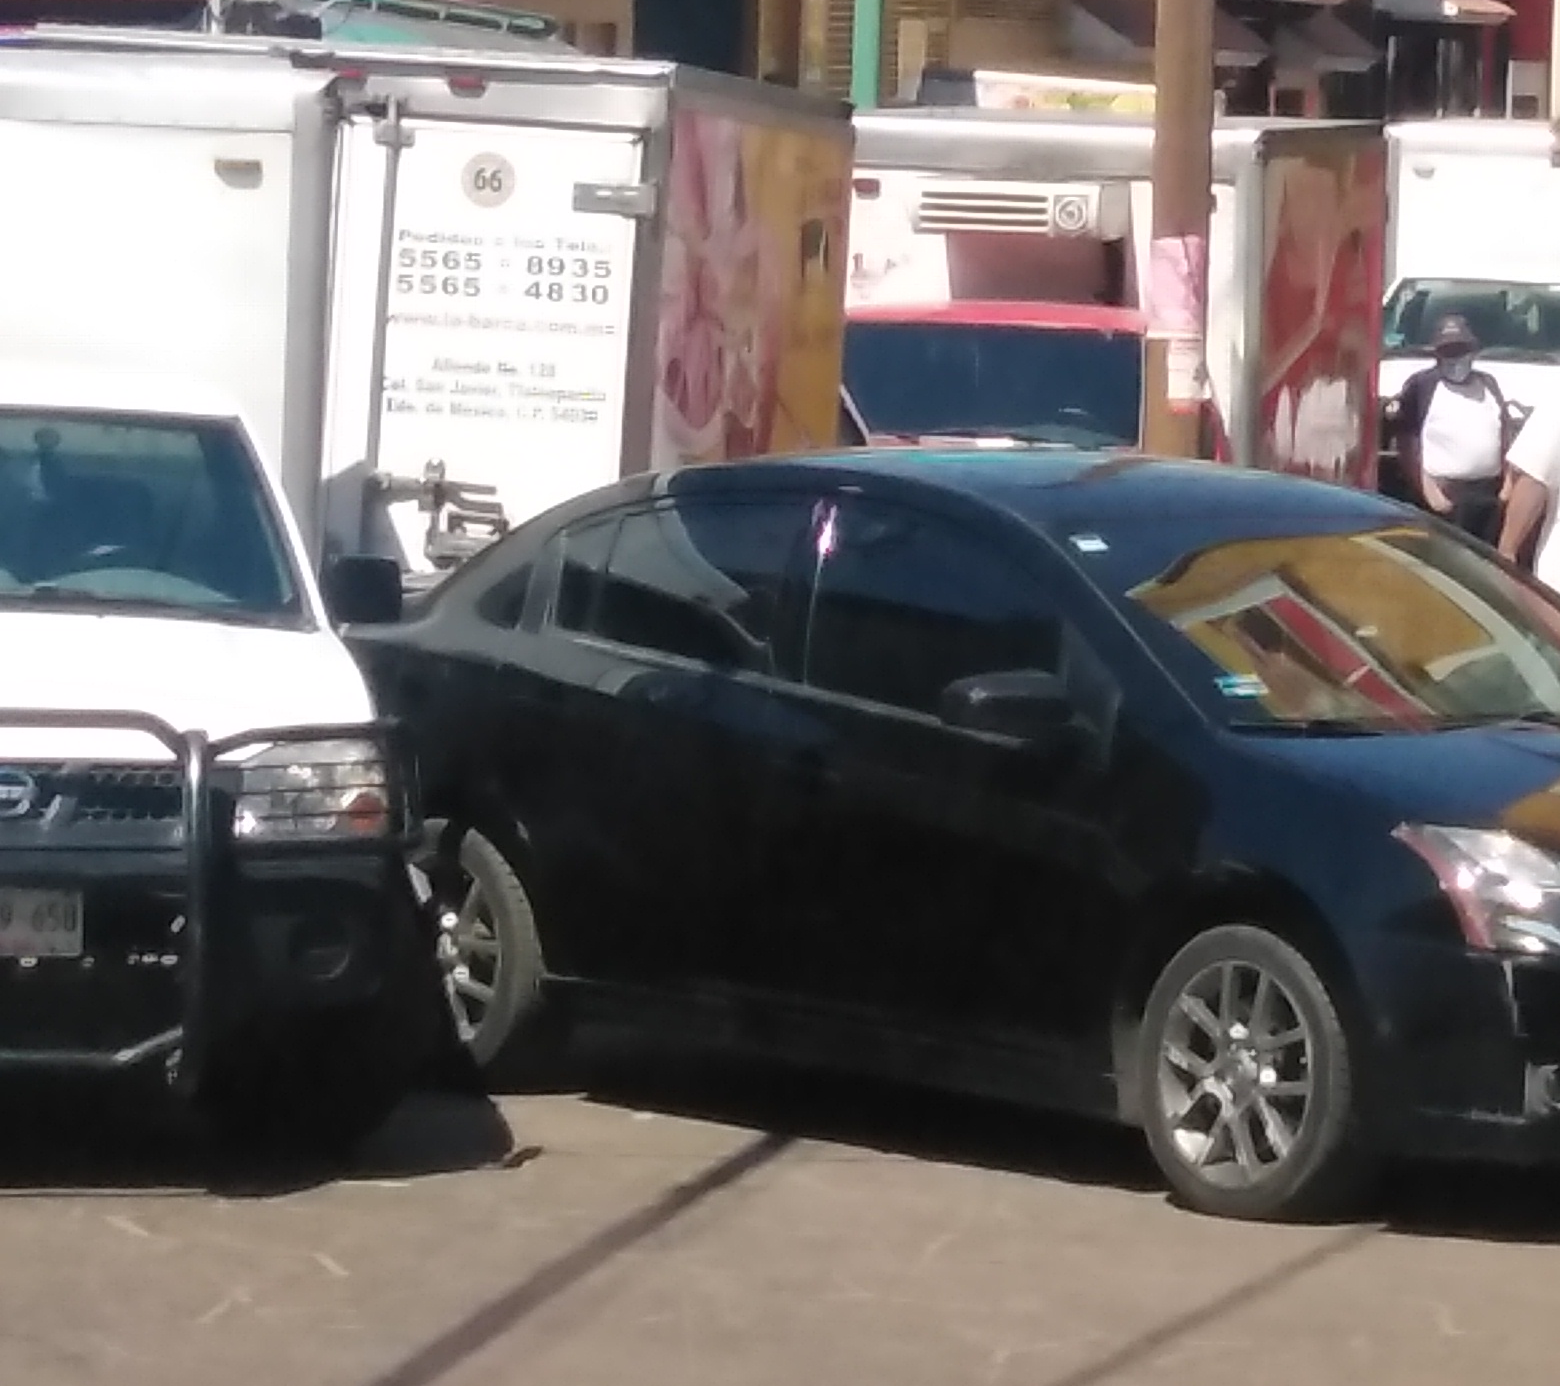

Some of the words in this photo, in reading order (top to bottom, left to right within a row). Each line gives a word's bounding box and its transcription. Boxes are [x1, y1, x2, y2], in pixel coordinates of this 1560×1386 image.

[474, 167, 502, 193] 66
[399, 248, 482, 271] 5565
[526, 255, 612, 279] 8935
[398, 274, 481, 297] 5565
[524, 281, 609, 305] 4830
